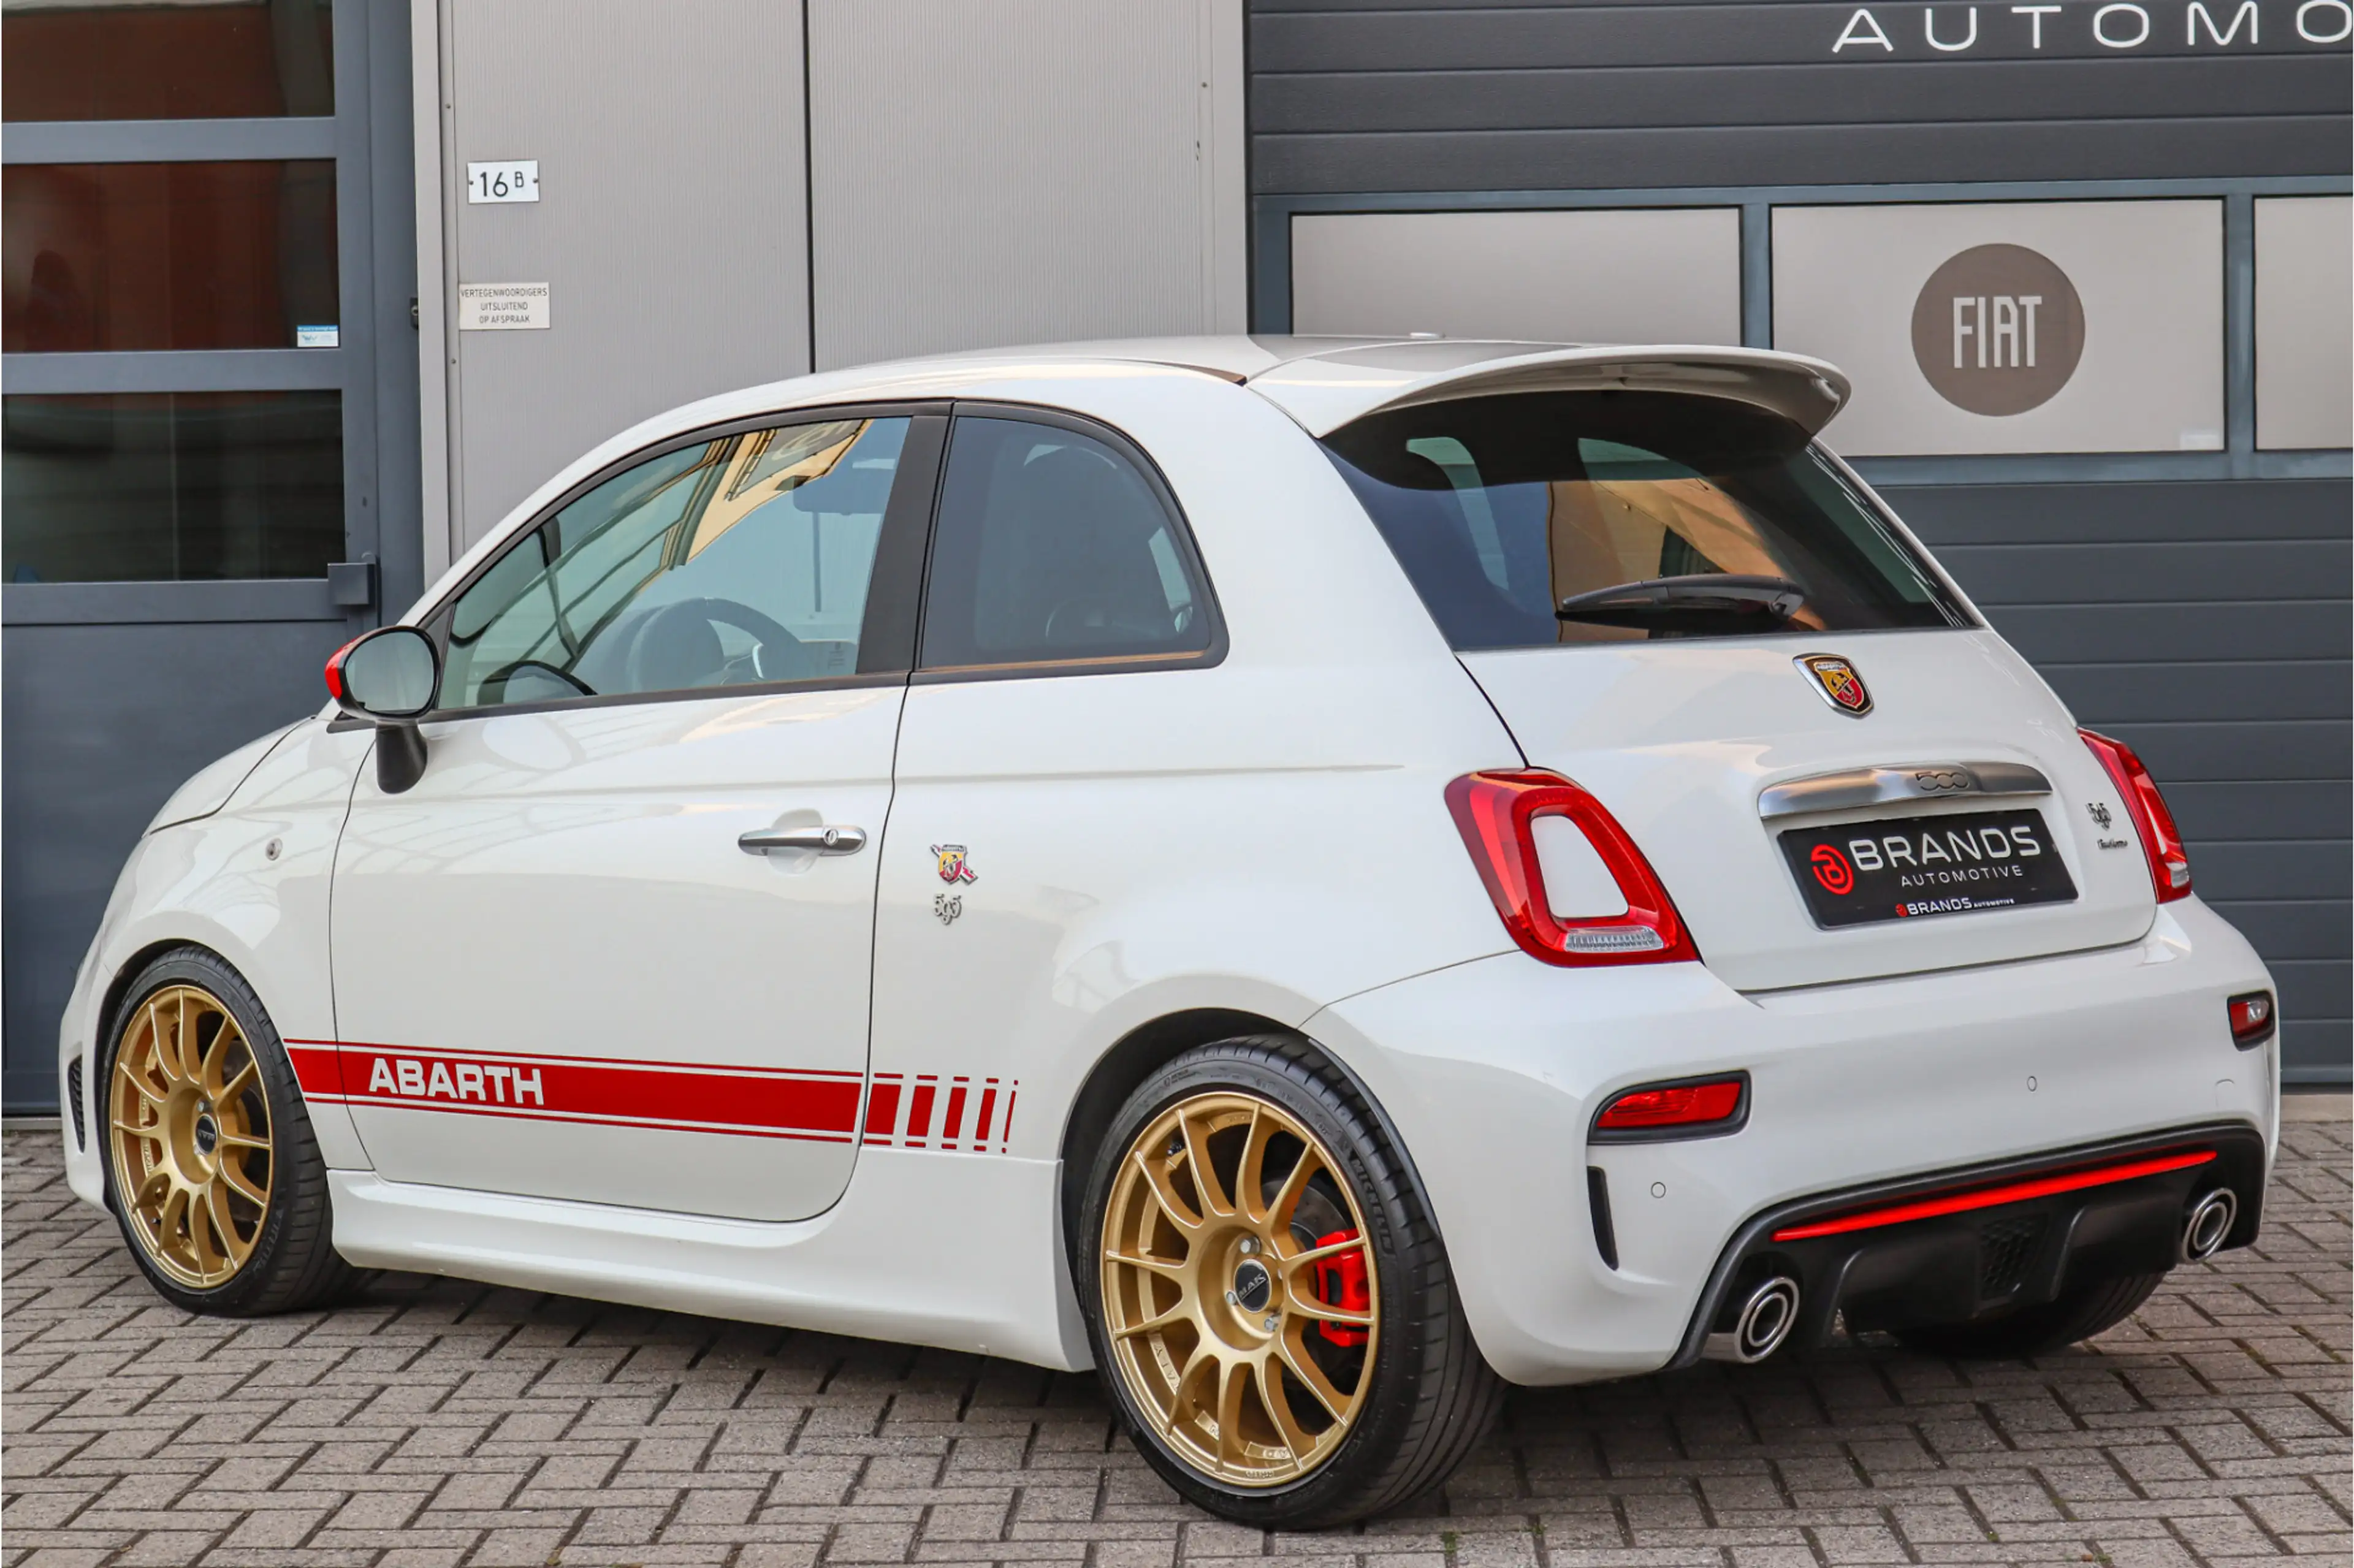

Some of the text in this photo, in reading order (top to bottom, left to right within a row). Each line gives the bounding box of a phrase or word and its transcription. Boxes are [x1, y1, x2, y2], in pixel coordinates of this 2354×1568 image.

[1832, 0, 2352, 53] AUTOMO
[479, 171, 509, 197] 16
[460, 287, 548, 298] VERTEGENWOORDIGERS
[480, 301, 528, 311] UITSLUITEND
[479, 314, 531, 324] OP AFSPRAAK
[1953, 295, 2042, 368] FIAT
[1914, 771, 1970, 791] 500
[1849, 826, 2041, 871] BRANDS
[1901, 865, 2024, 888] AUTOMOTIVE
[1906, 897, 2016, 916] BRANDS AUTOMOTIVE
[369, 1057, 544, 1106] ABARTH
[1350, 1159, 1393, 1249] MICHELIN
